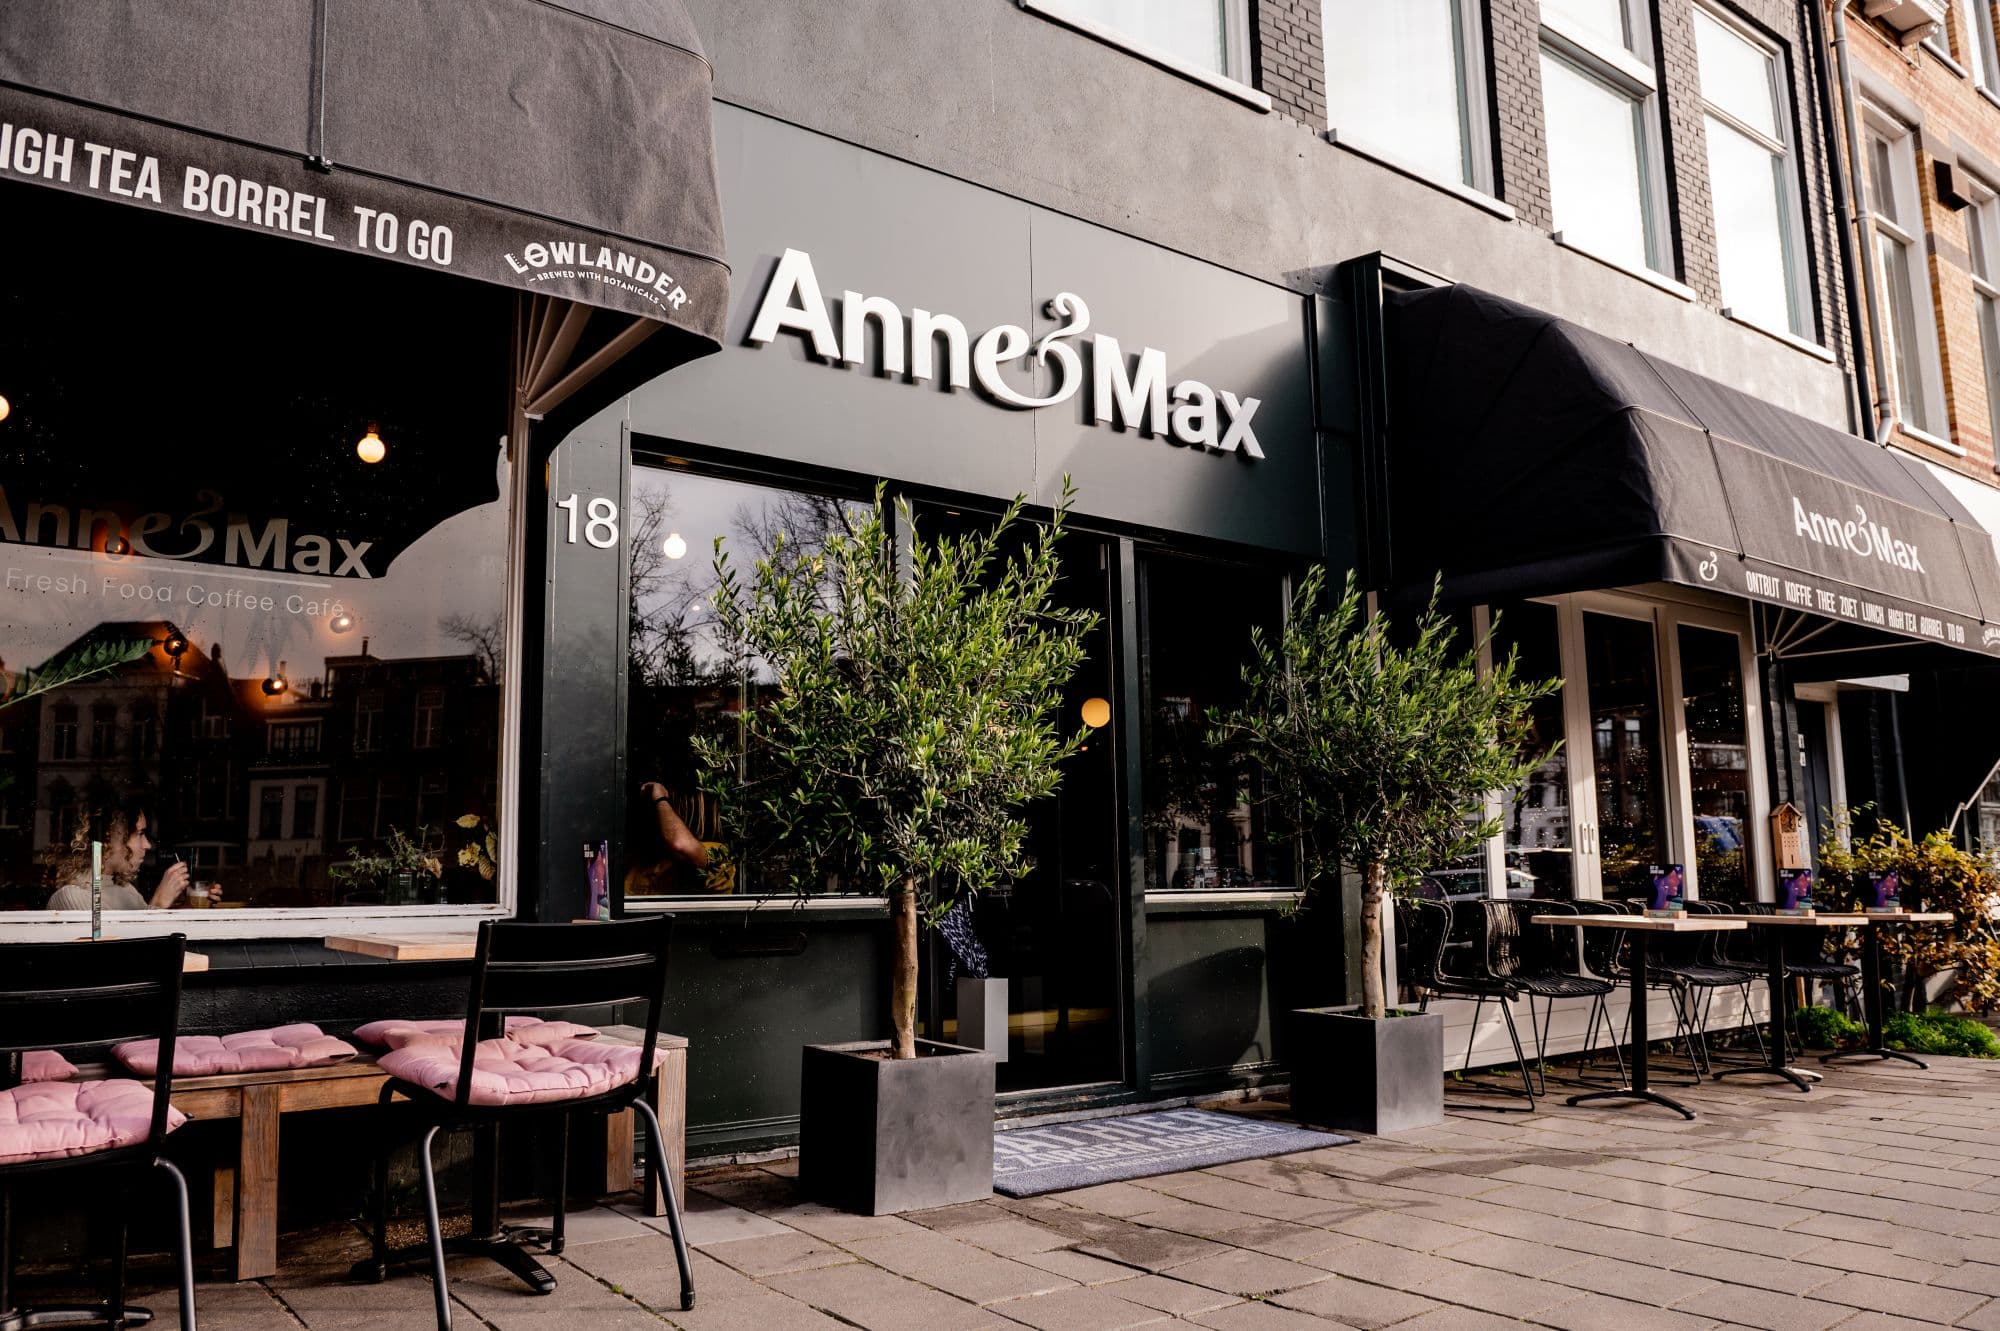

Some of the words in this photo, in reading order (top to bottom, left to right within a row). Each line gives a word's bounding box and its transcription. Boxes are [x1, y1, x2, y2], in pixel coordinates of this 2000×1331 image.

[84, 142, 162, 204] TEA
[183, 166, 335, 242] BORREL
[354, 205, 398, 254] TO
[407, 220, 454, 266] GO
[536, 270, 575, 282] BREWED
[577, 271, 601, 281] WITH
[603, 275, 660, 305] BOTANICALS
[556, 494, 620, 549] 18
[6, 567, 88, 595] Fresh
[101, 577, 173, 602] Food
[185, 585, 275, 613] Coffee
[286, 592, 345, 619] Café
[1784, 580, 1813, 607] KOFFIE
[1815, 588, 1837, 613] THEE
[1839, 595, 1858, 619] ZOET
[1861, 601, 1885, 625] LUNCH
[1887, 608, 1905, 630] HIGH
[1904, 612, 1918, 633] TEA
[1920, 616, 1945, 639] BORREL
[1946, 622, 1956, 642] TO
[1955, 625, 1965, 644] GO
[1061, 1111, 1244, 1141] HIER
